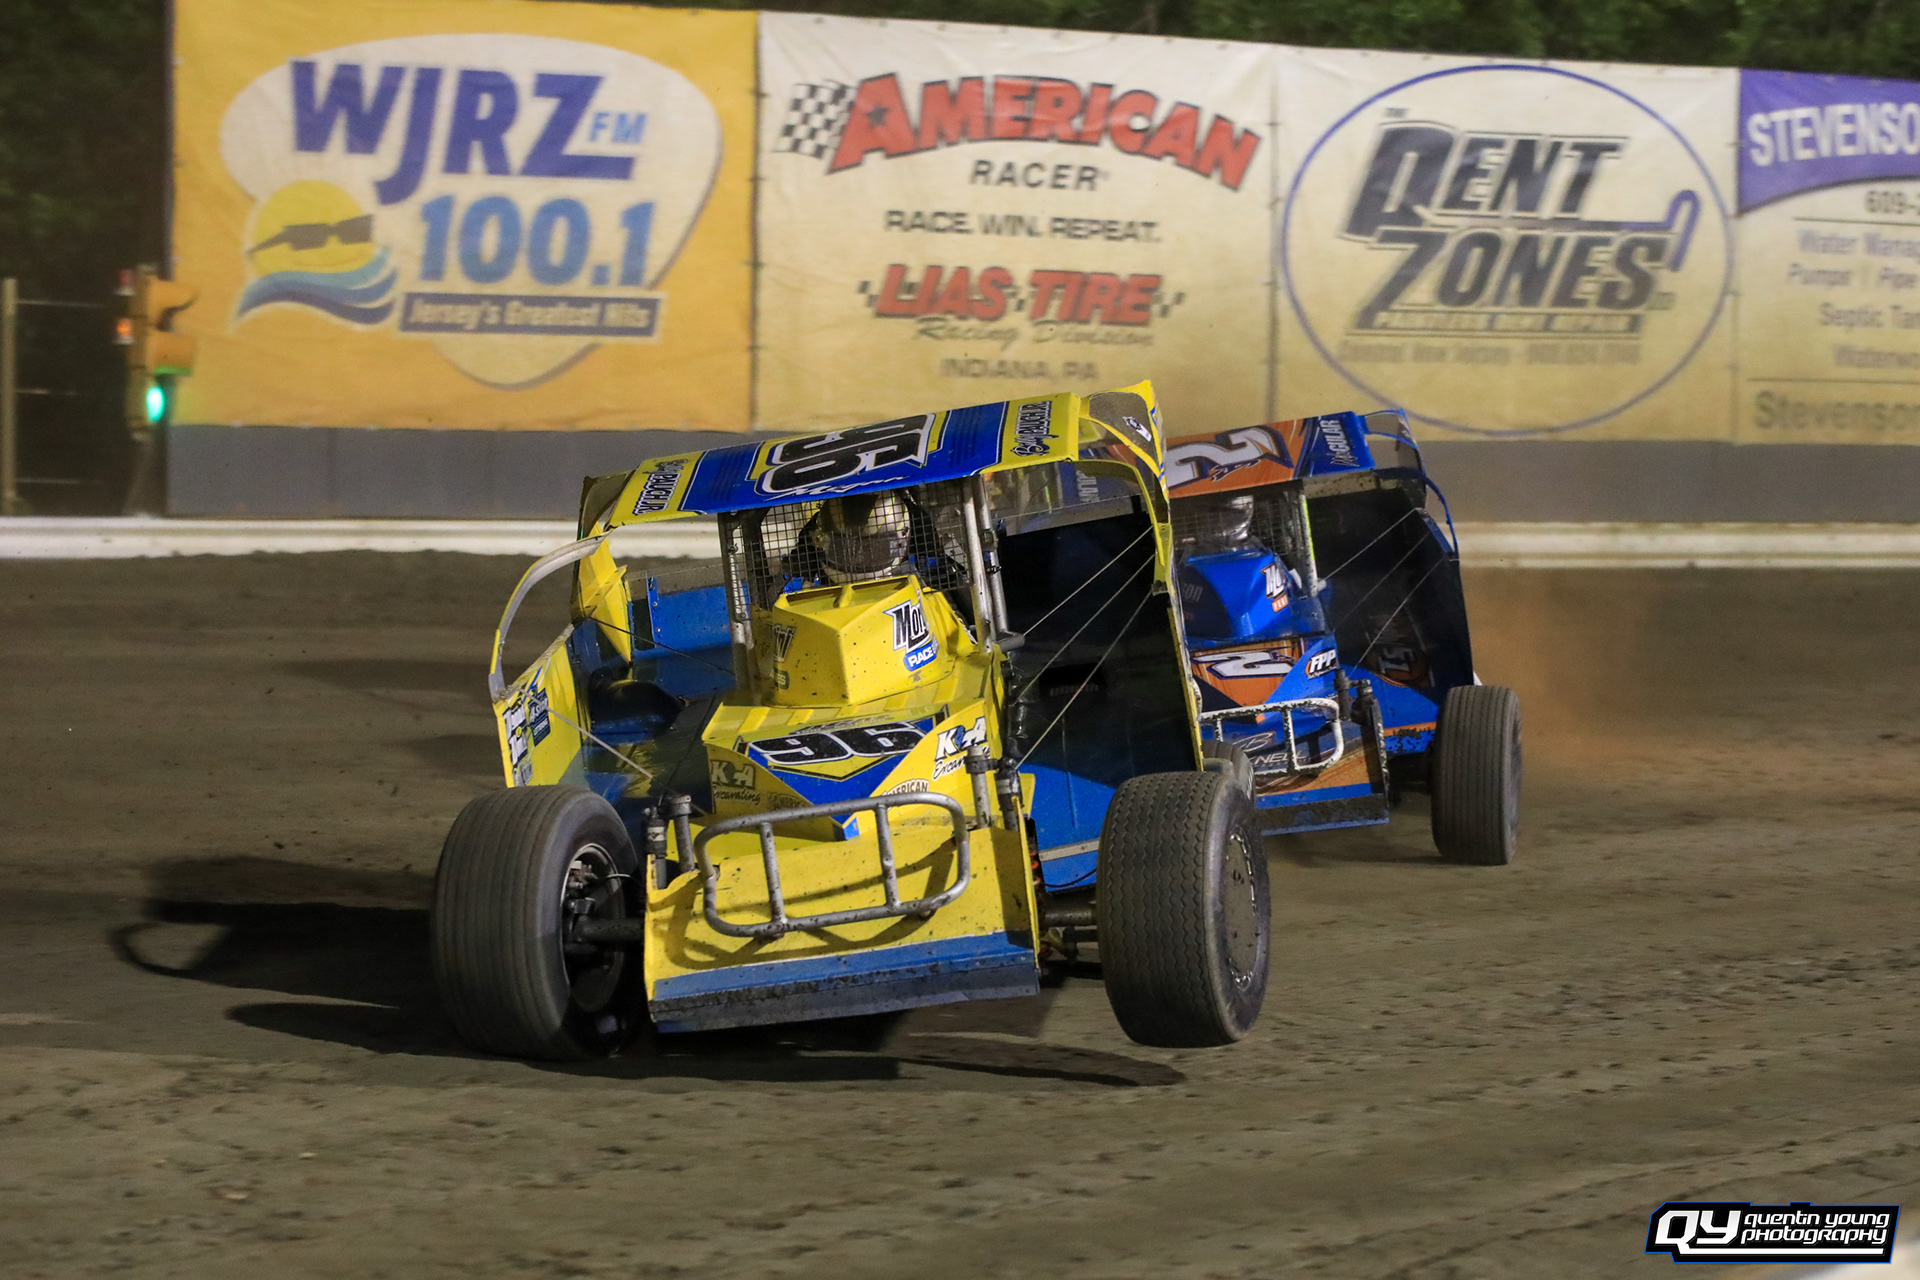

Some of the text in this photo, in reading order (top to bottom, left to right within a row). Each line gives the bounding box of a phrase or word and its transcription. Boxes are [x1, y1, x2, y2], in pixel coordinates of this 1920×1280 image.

[289, 60, 648, 206] WJRZ FM
[826, 72, 1262, 192] AMERICAN
[969, 160, 1099, 191] RACER
[1866, 190, 1920, 215] 609-
[420, 195, 656, 287] 100.1
[873, 263, 1164, 327] LIAS TIRE
[1352, 228, 1670, 332] ZONES
[504, 300, 598, 328] Greatest
[603, 302, 650, 328] Hits
[1309, 650, 1337, 674] FPP
